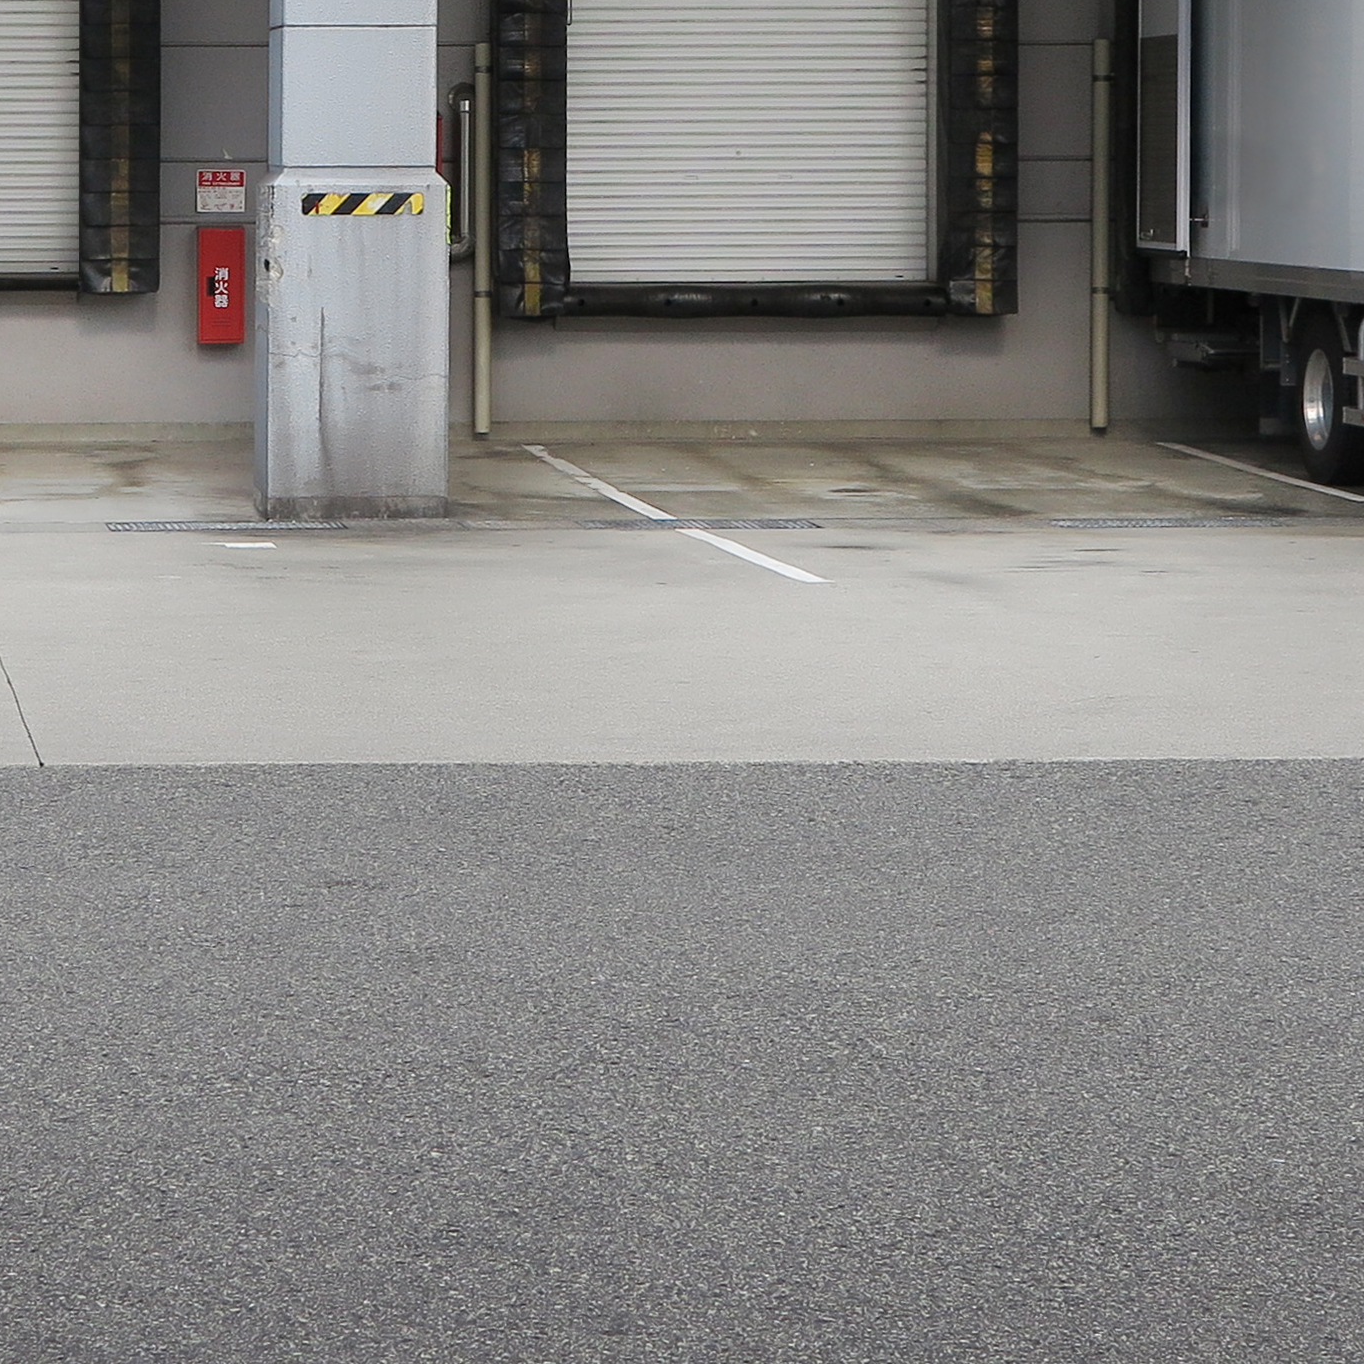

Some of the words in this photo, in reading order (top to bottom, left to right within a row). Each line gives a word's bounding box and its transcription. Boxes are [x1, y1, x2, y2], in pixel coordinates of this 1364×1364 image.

[201, 172, 241, 181] 消火器
[214, 267, 229, 308] 消火器
